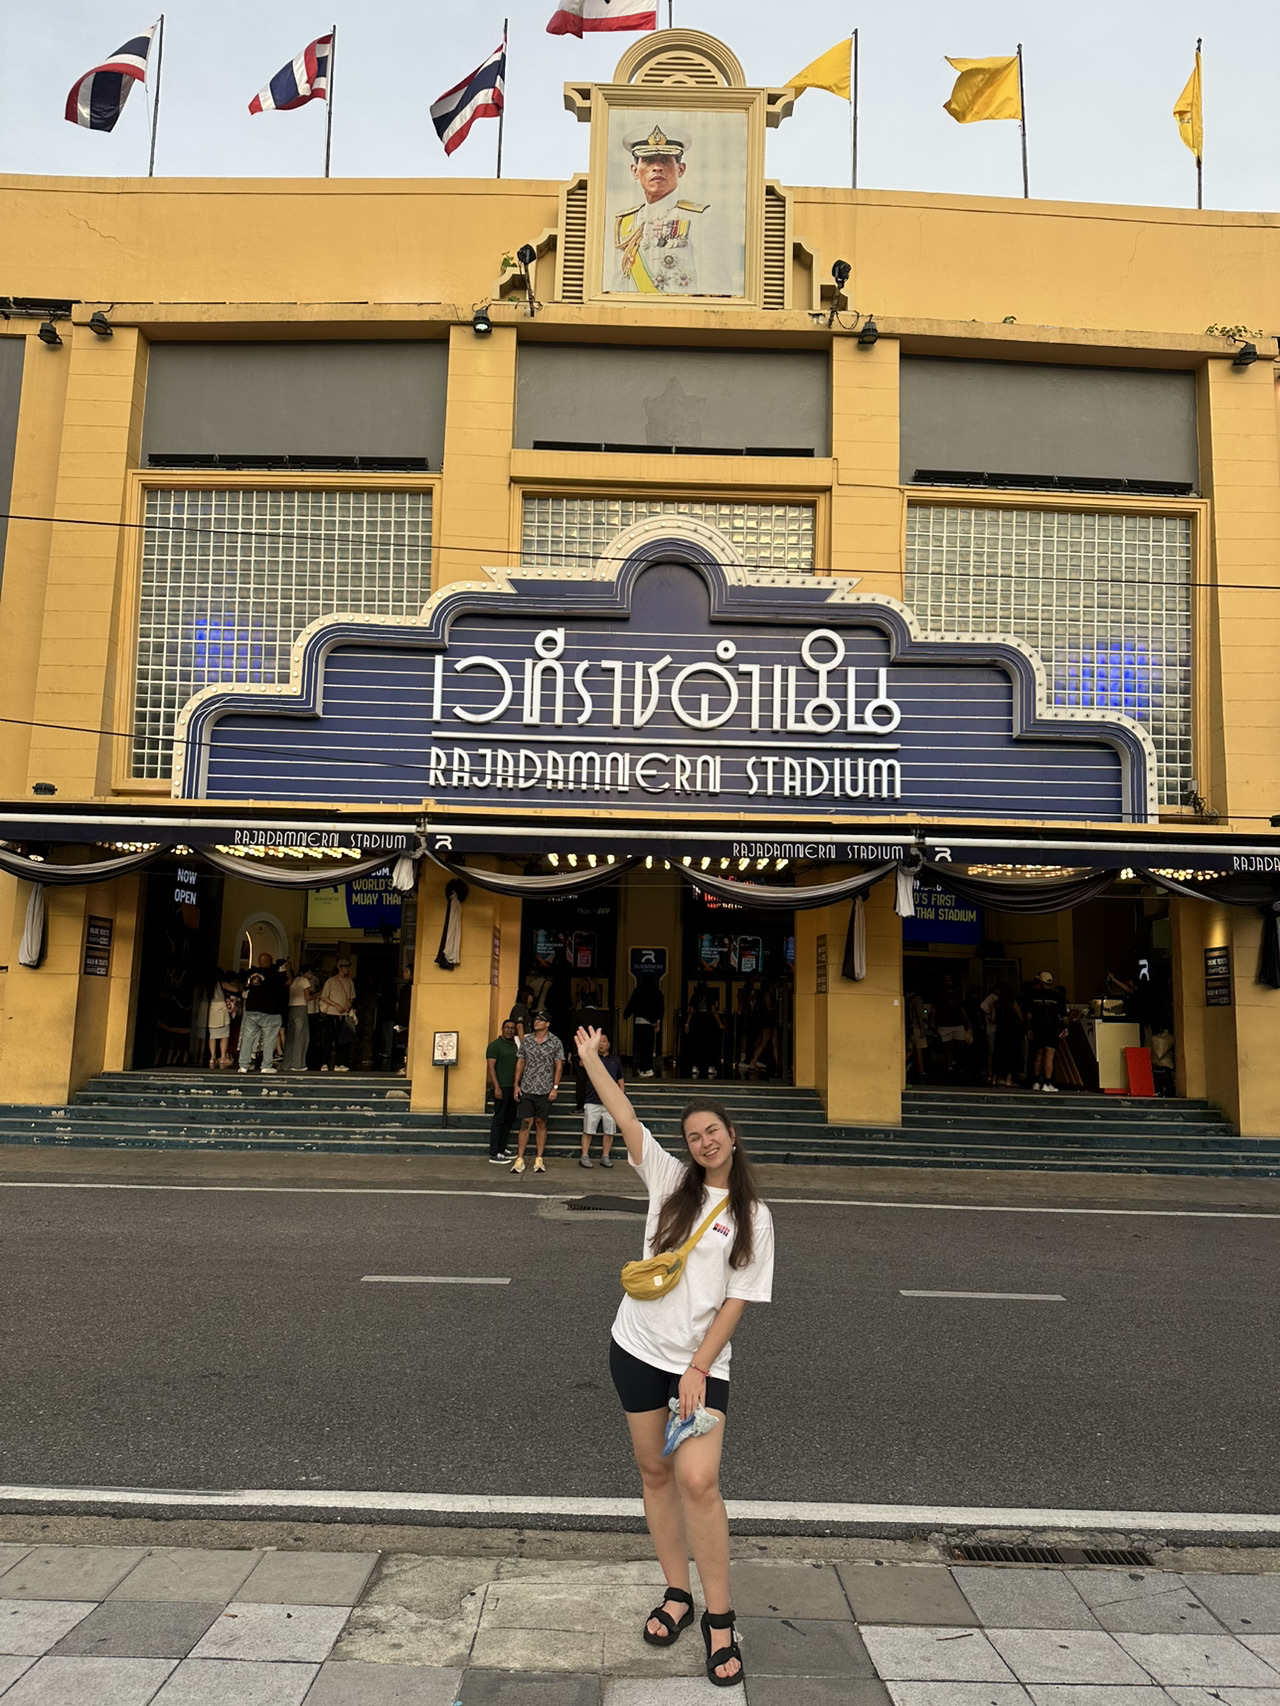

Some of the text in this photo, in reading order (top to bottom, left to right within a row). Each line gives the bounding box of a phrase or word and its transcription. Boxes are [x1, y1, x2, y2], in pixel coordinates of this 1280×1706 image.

[432, 627, 902, 735] เวทีราชดำเนิน
[429, 746, 902, 800] RAJADAMNERN STADIUM
[234, 830, 407, 849] RAJADAMNERN STADIUM
[732, 842, 904, 860] RAJADAMNERN STADIUM
[177, 868, 197, 885] NOW
[352, 878, 393, 891] WORLD'S
[174, 888, 197, 905] OPEN
[352, 892, 379, 905] MUAY
[382, 893, 402, 905] THAI
[931, 893, 956, 907] FIRST
[916, 906, 977, 922] THAI STADIUM
